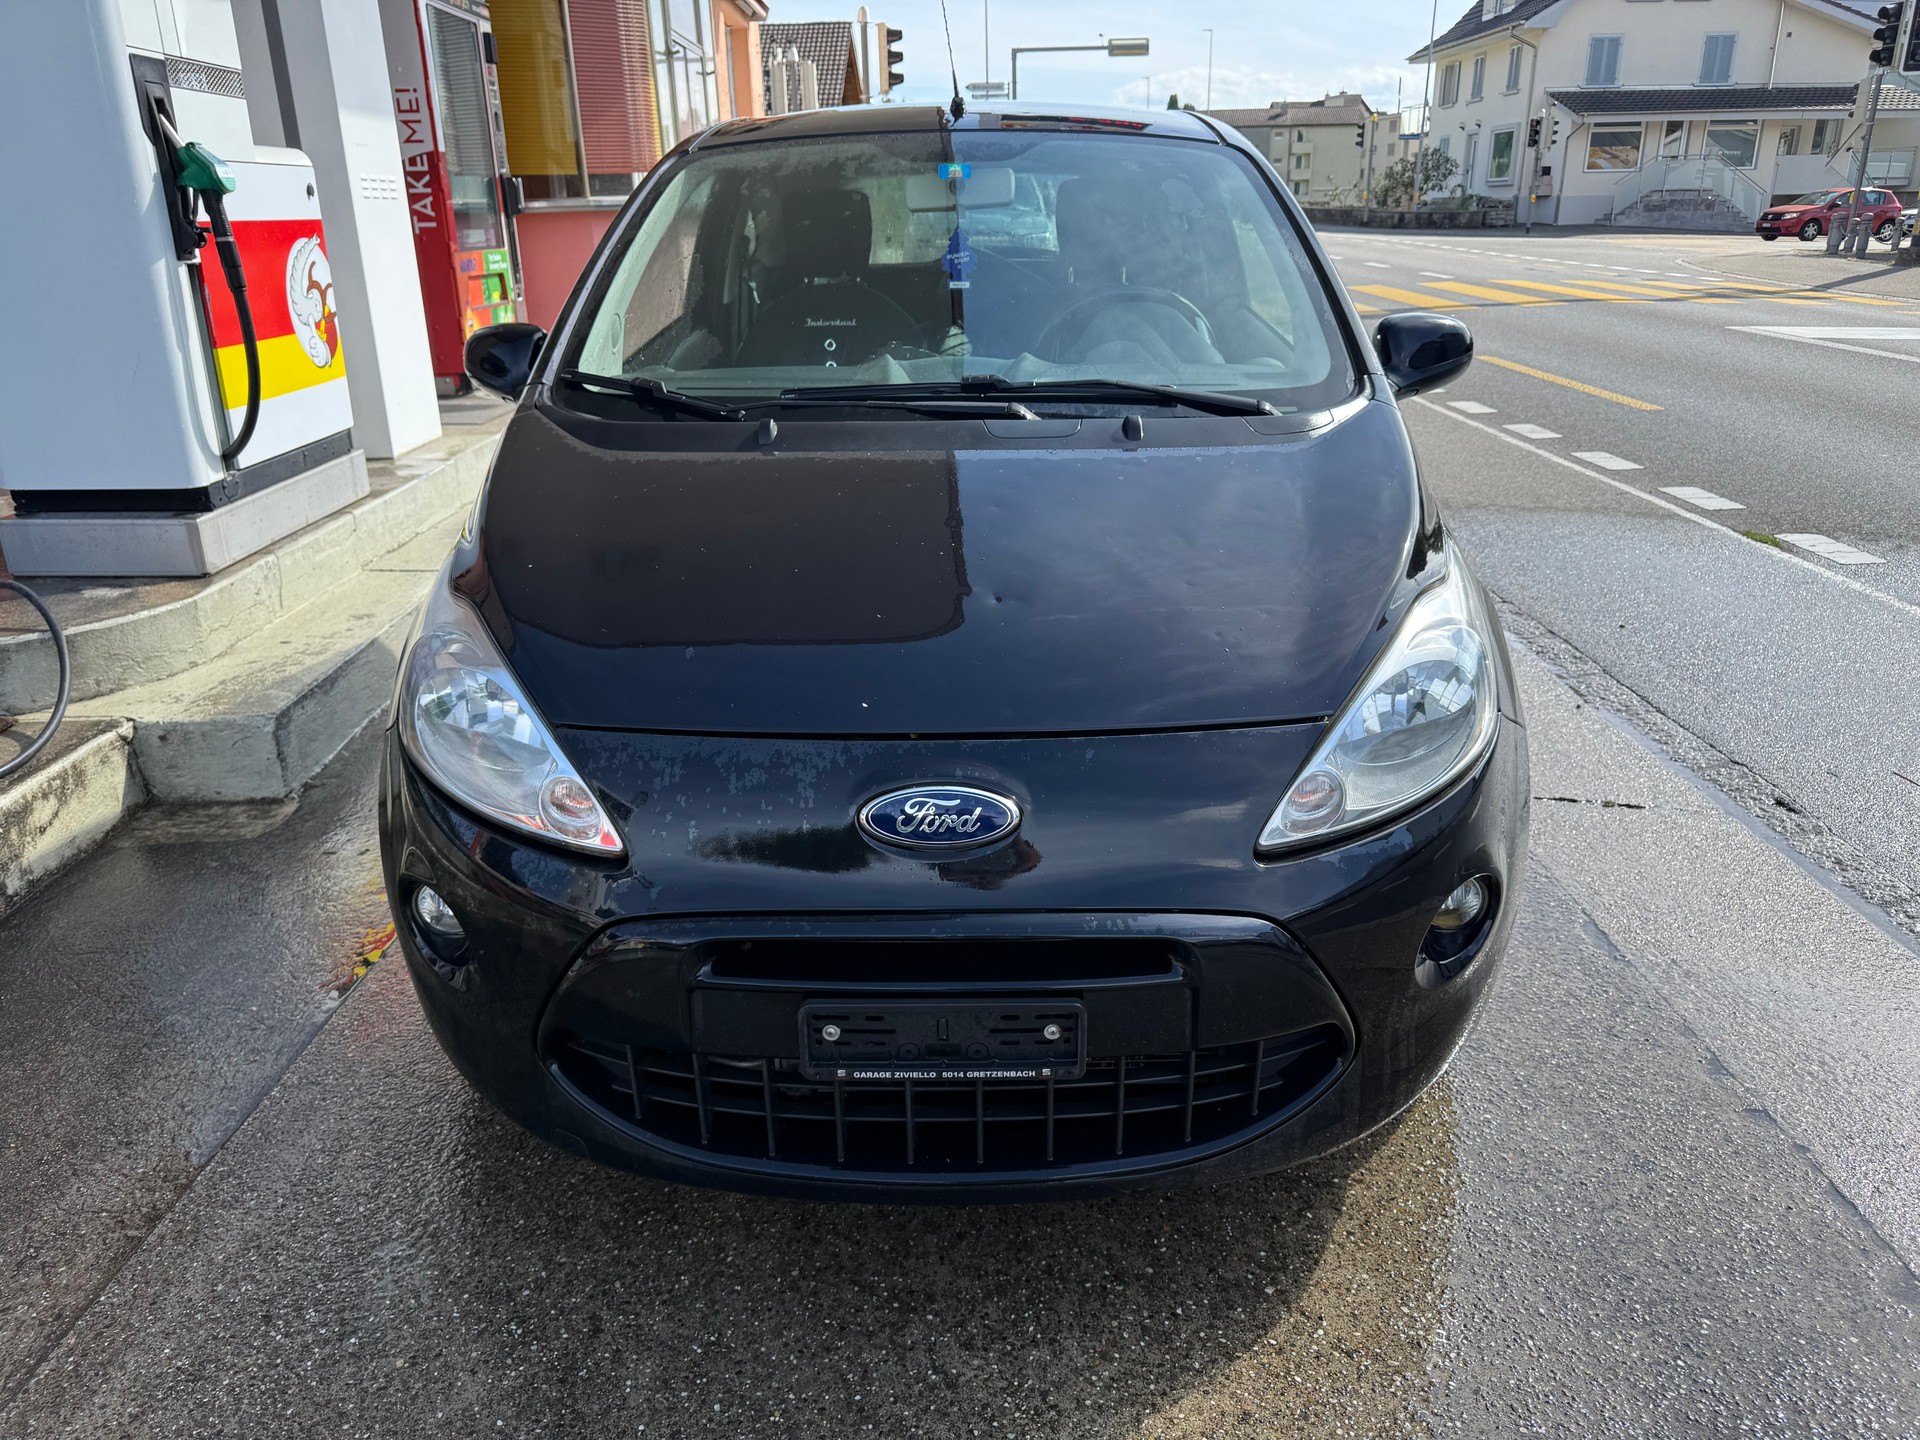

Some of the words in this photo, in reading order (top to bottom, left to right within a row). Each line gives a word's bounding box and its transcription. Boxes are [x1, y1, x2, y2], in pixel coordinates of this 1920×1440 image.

[395, 87, 425, 144] ME!
[404, 153, 437, 234] TAKE
[895, 797, 983, 833] Ford
[966, 1070, 1036, 1078] GRETZENBACH
